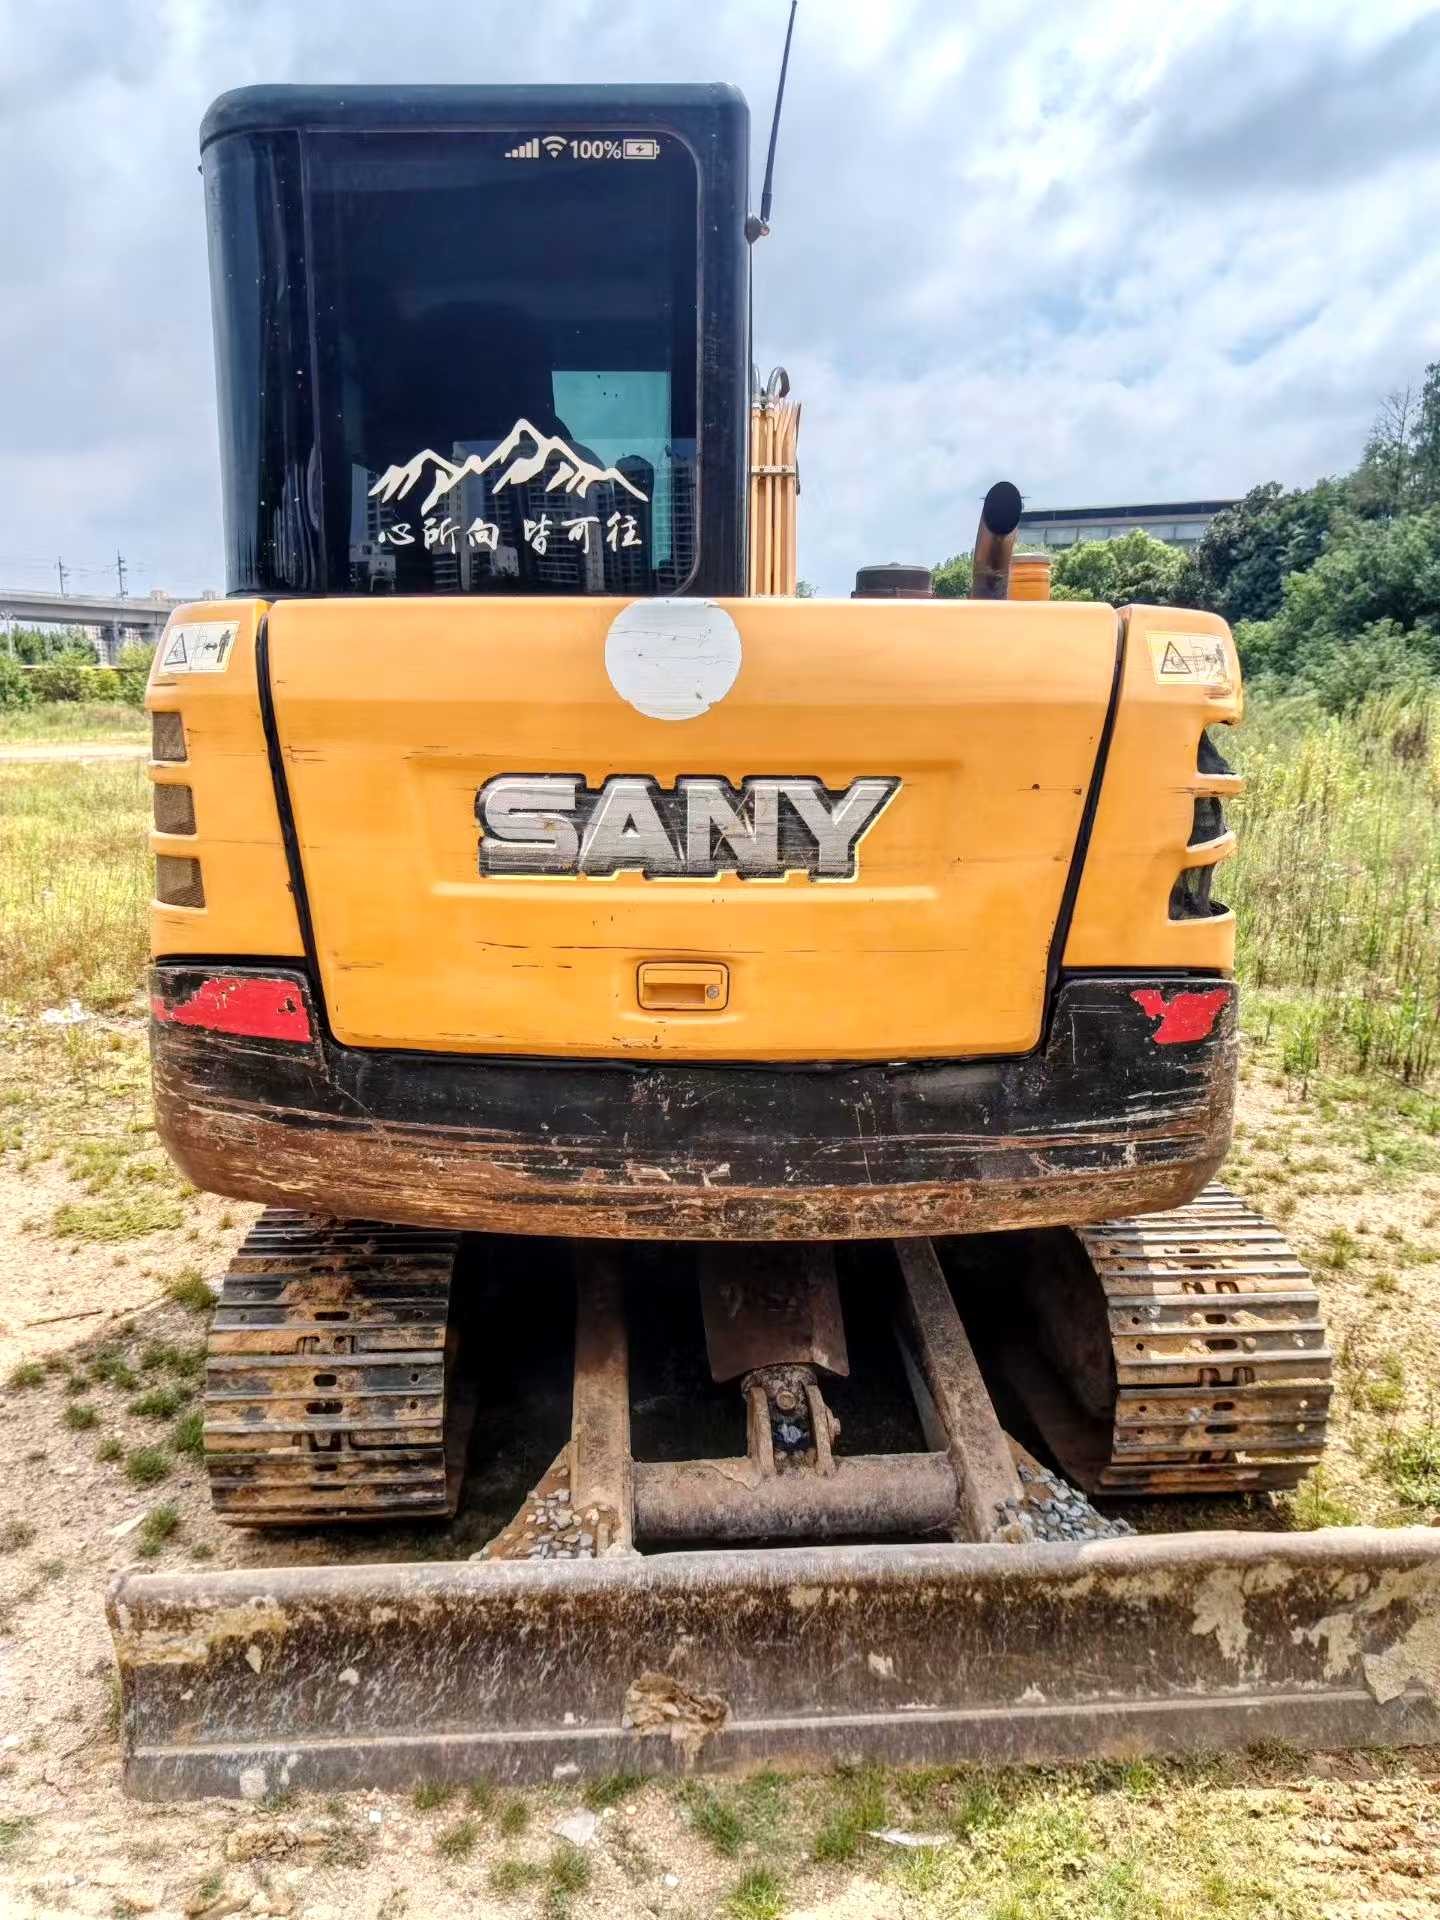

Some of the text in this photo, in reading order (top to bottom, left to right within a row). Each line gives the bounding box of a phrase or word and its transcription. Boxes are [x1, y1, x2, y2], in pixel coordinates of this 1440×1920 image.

[570, 139, 622, 159] 100%
[378, 511, 643, 555] 心所向 皆可往
[476, 774, 901, 880] SANY
